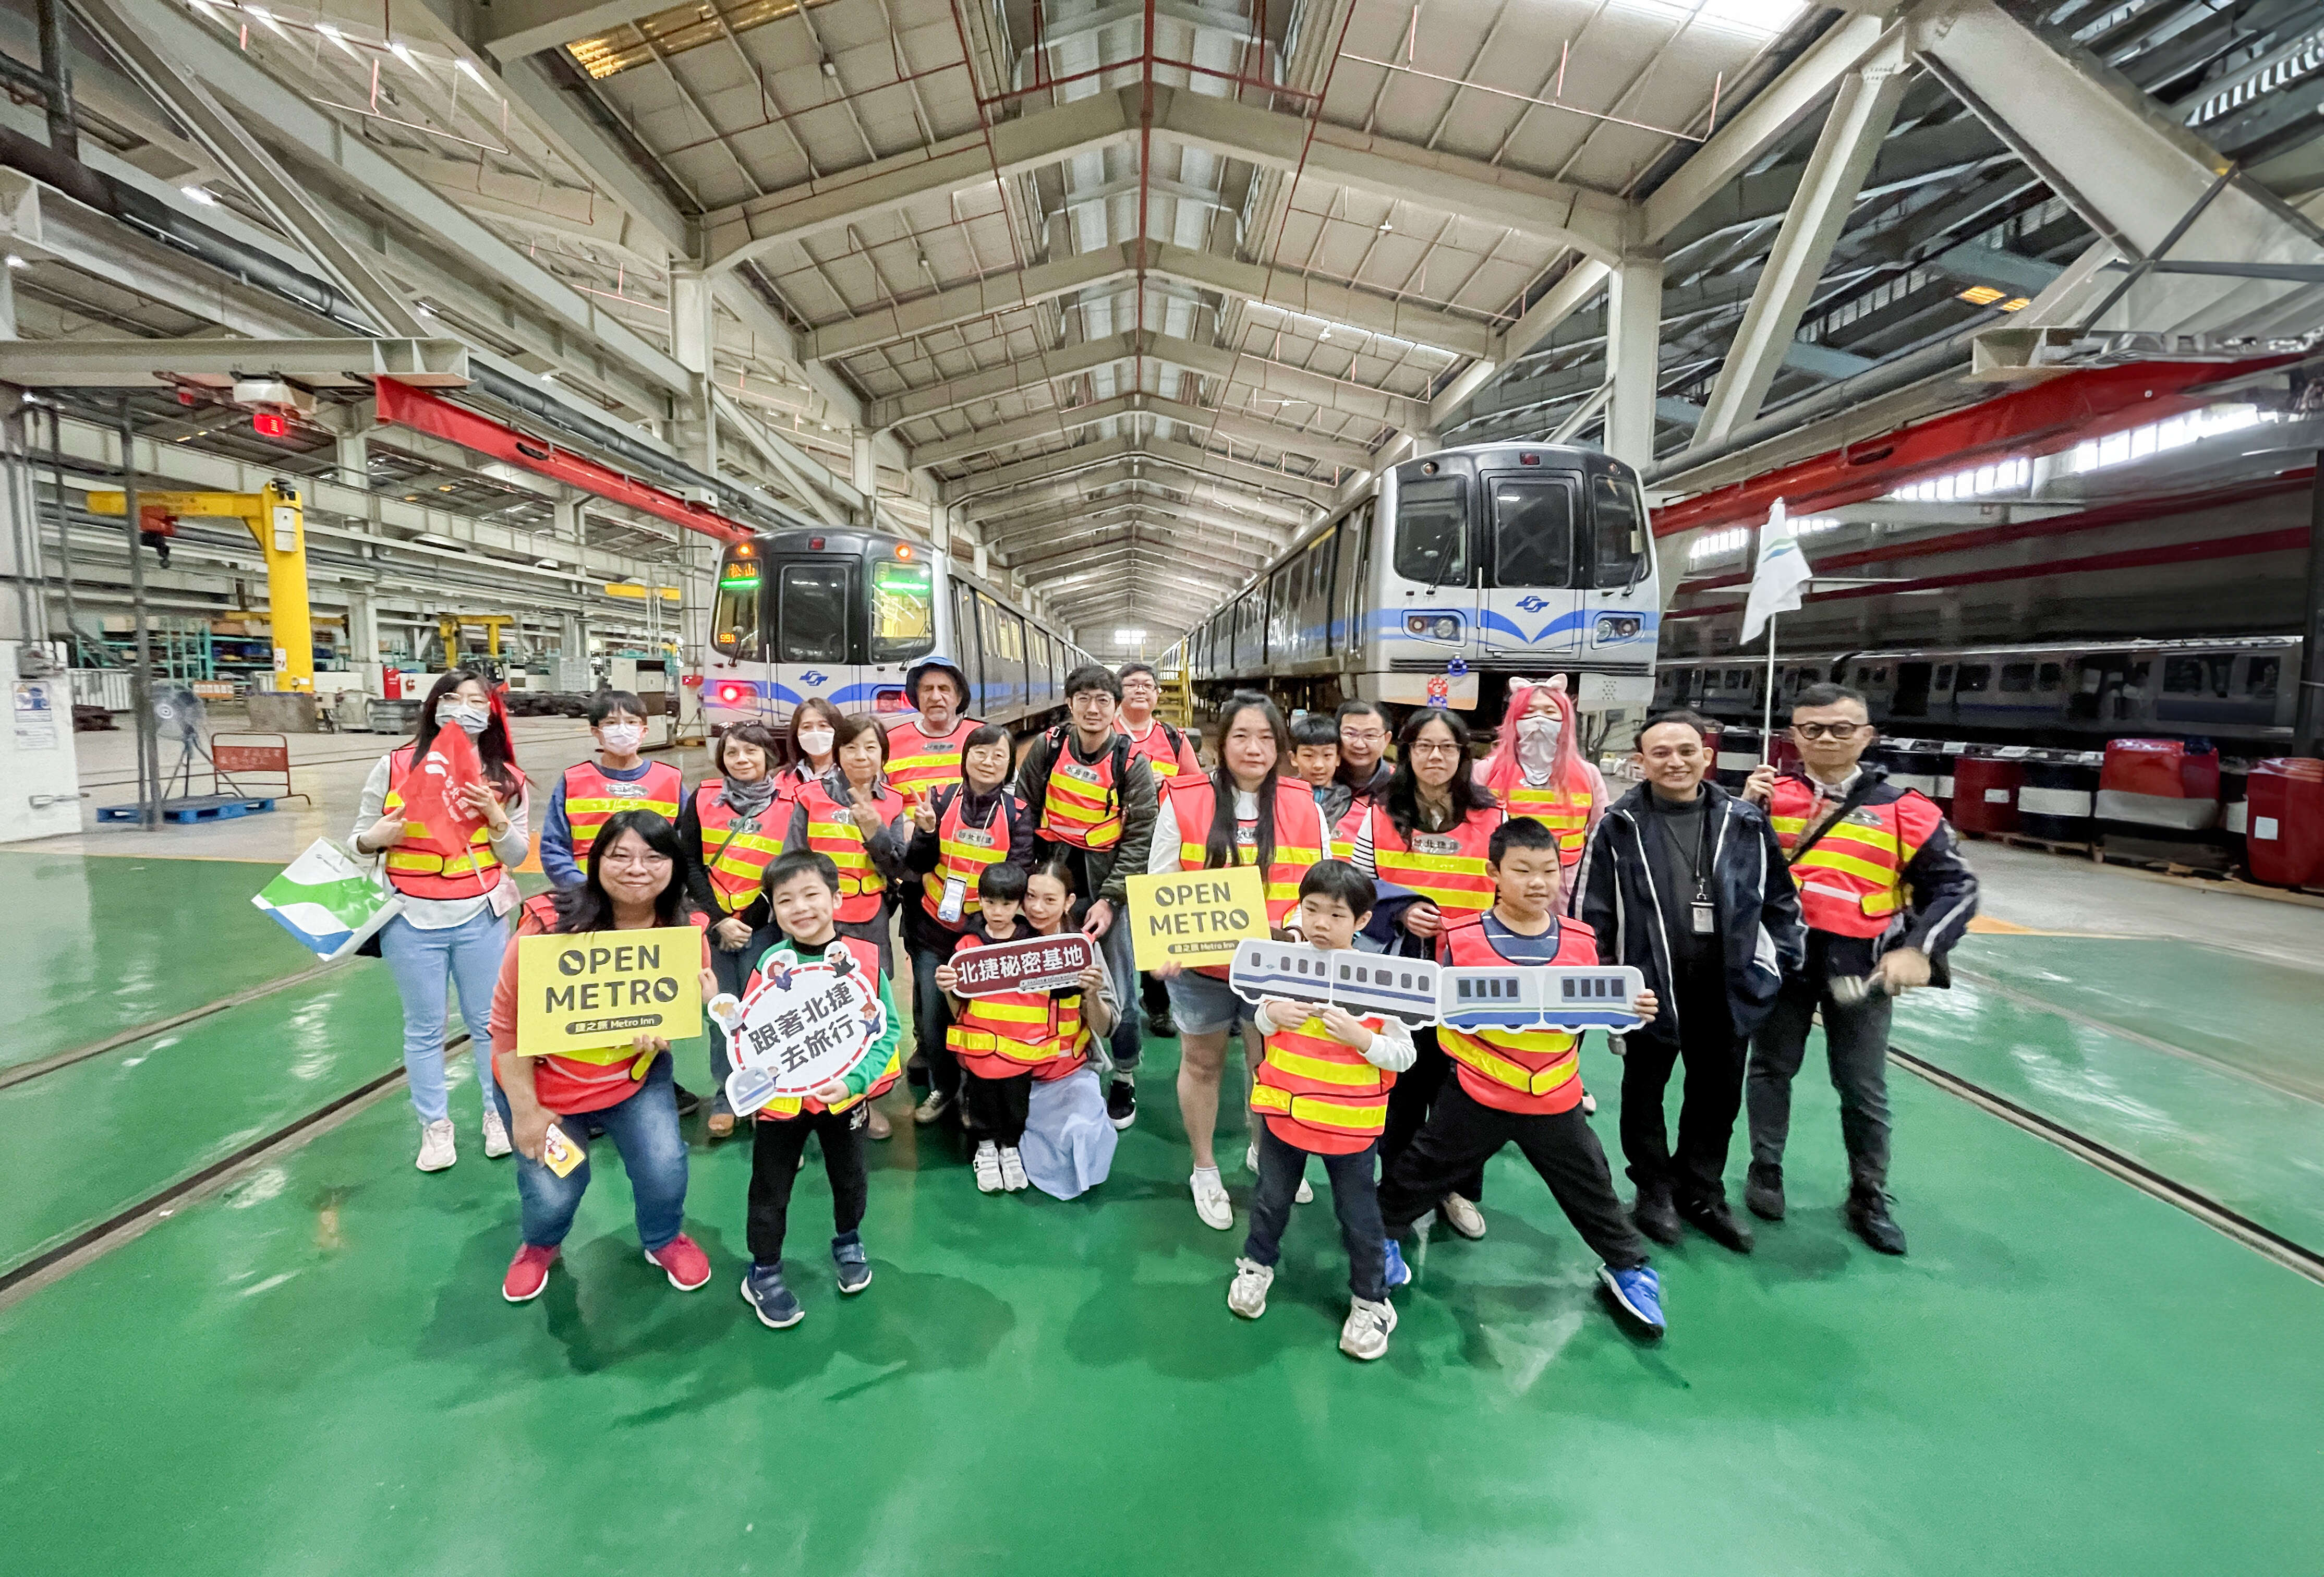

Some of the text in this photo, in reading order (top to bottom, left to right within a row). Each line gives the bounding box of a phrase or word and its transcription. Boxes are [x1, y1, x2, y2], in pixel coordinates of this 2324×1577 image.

[730, 563, 756, 578] 松山
[719, 634, 736, 644] 991
[1155, 881, 1231, 907] OPEN
[1149, 908, 1249, 936] METRO
[558, 944, 660, 976] OPEN
[957, 944, 1085, 985] 北捷秘密基地
[545, 977, 679, 1013] METRO
[610, 1020, 638, 1028] Metro
[748, 981, 855, 1056] 跟著北捷
[780, 1013, 855, 1073] 去旅行
